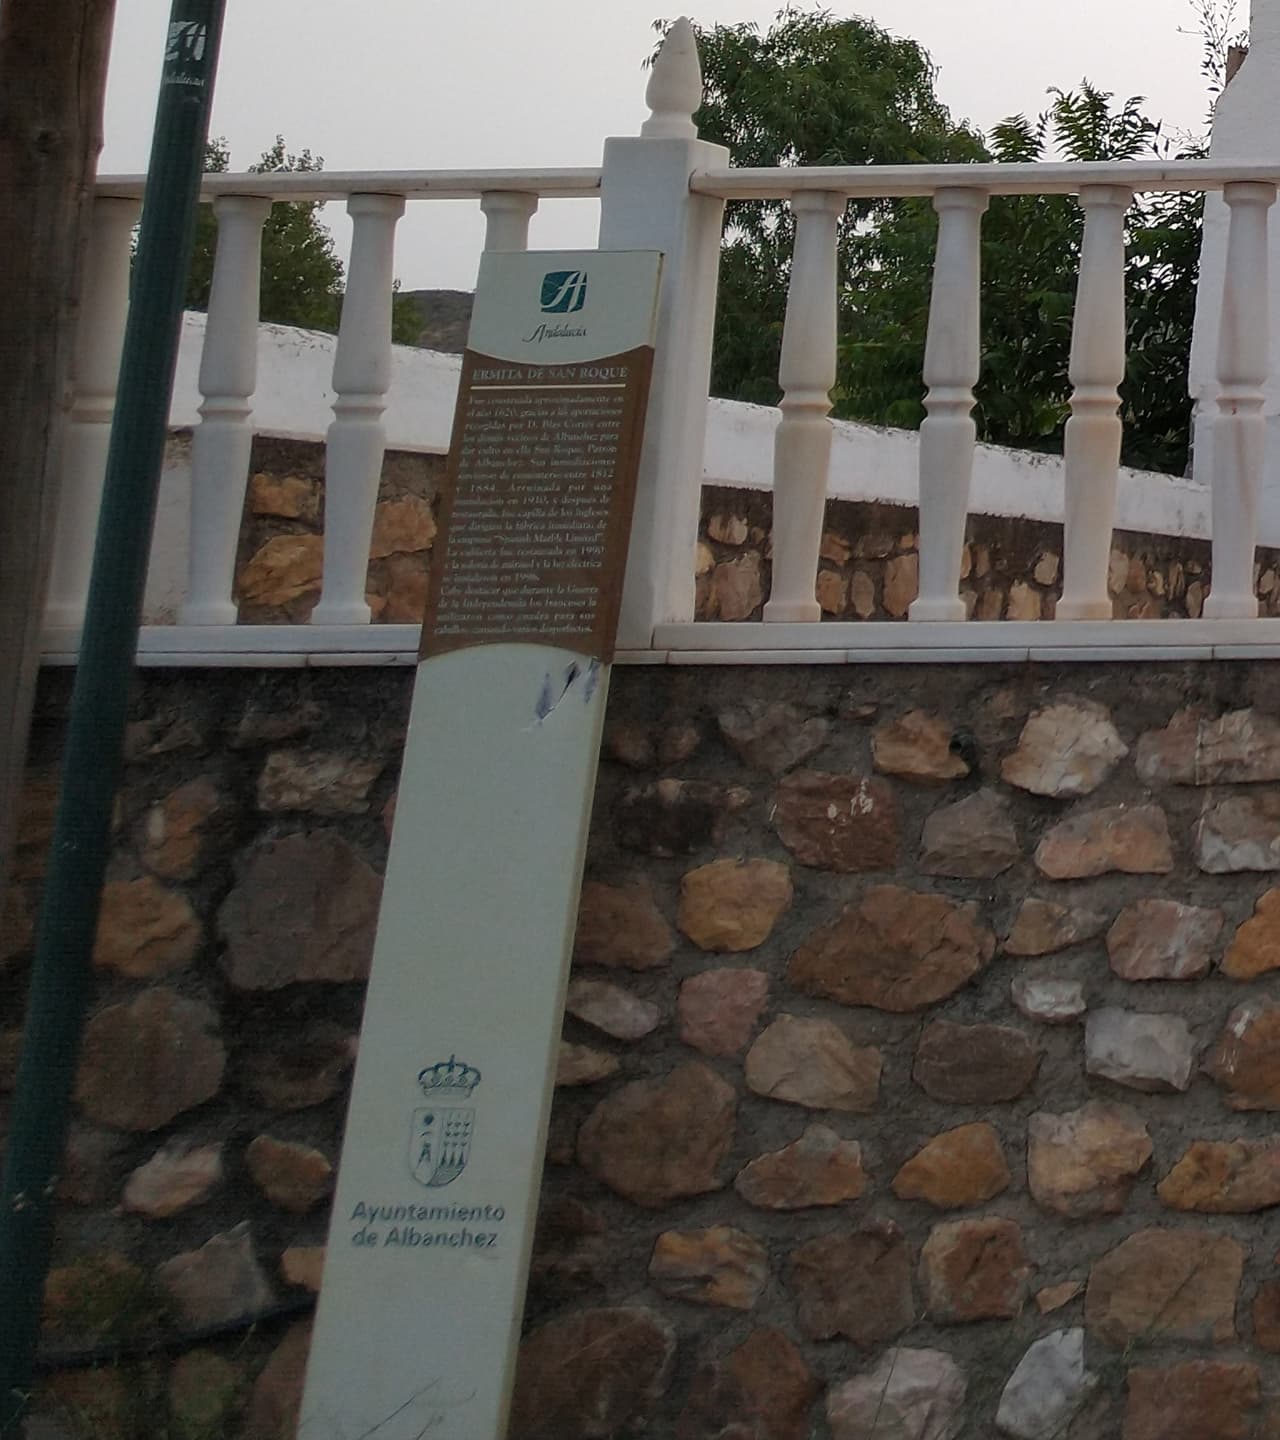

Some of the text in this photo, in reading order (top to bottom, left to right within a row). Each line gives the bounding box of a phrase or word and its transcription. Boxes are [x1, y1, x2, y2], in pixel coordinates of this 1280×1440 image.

[472, 368, 522, 380] ERMITA
[528, 368, 544, 379] DE
[580, 367, 628, 379] ROQUE
[351, 1201, 505, 1225] Ayuntamiento
[351, 1226, 498, 1248] de Albanchez
